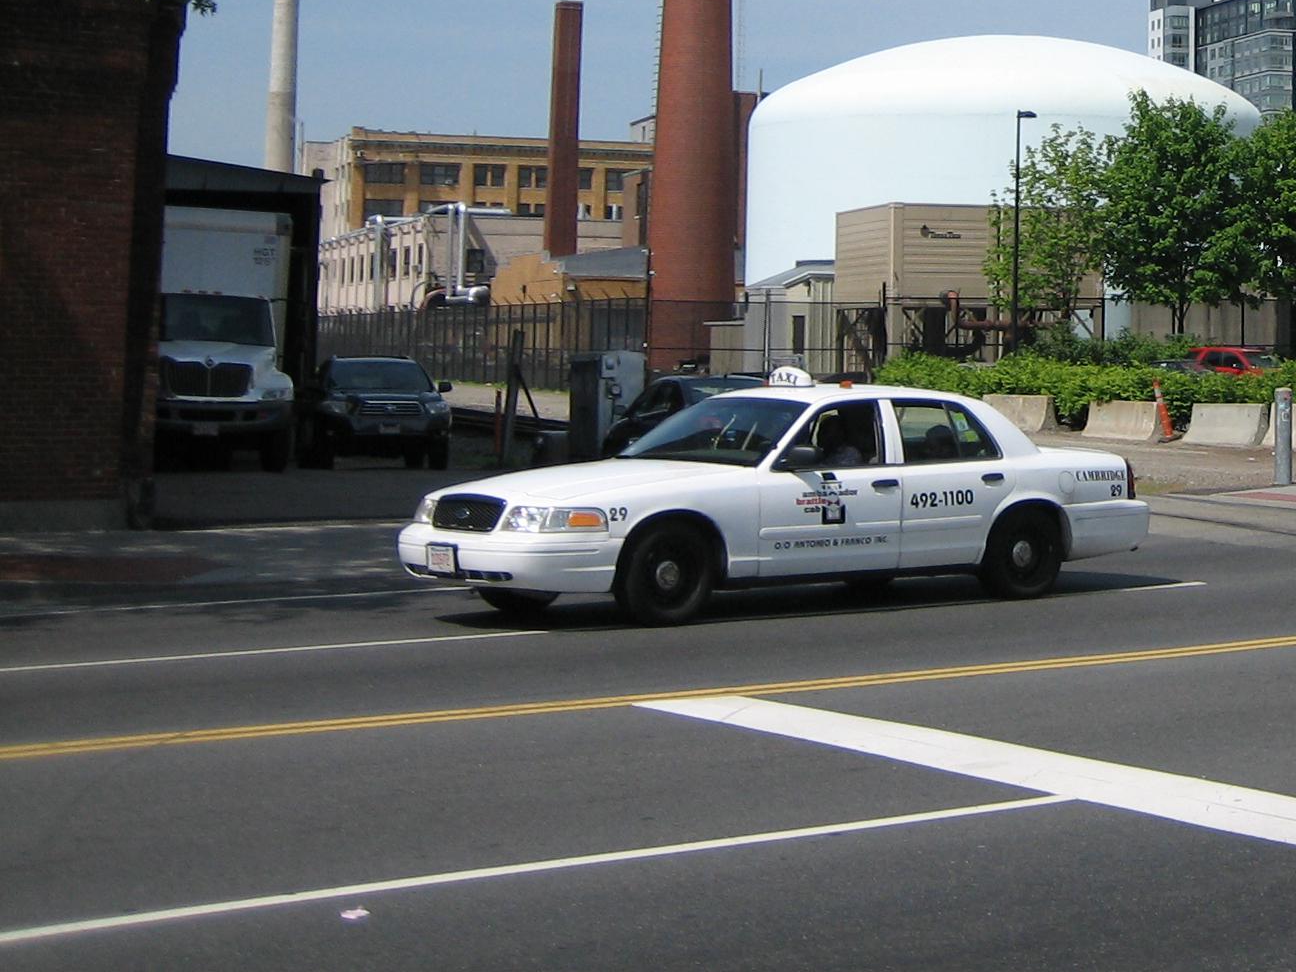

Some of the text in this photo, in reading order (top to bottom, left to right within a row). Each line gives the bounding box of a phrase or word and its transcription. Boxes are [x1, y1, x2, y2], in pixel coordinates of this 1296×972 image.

[771, 372, 798, 385] TAXI
[1075, 469, 1126, 482] CAMBRIDGE
[802, 489, 858, 498] ambaador
[1110, 484, 1122, 497] 29
[910, 489, 974, 508] 492-1100
[609, 506, 628, 522] 29
[804, 506, 821, 514] cab
